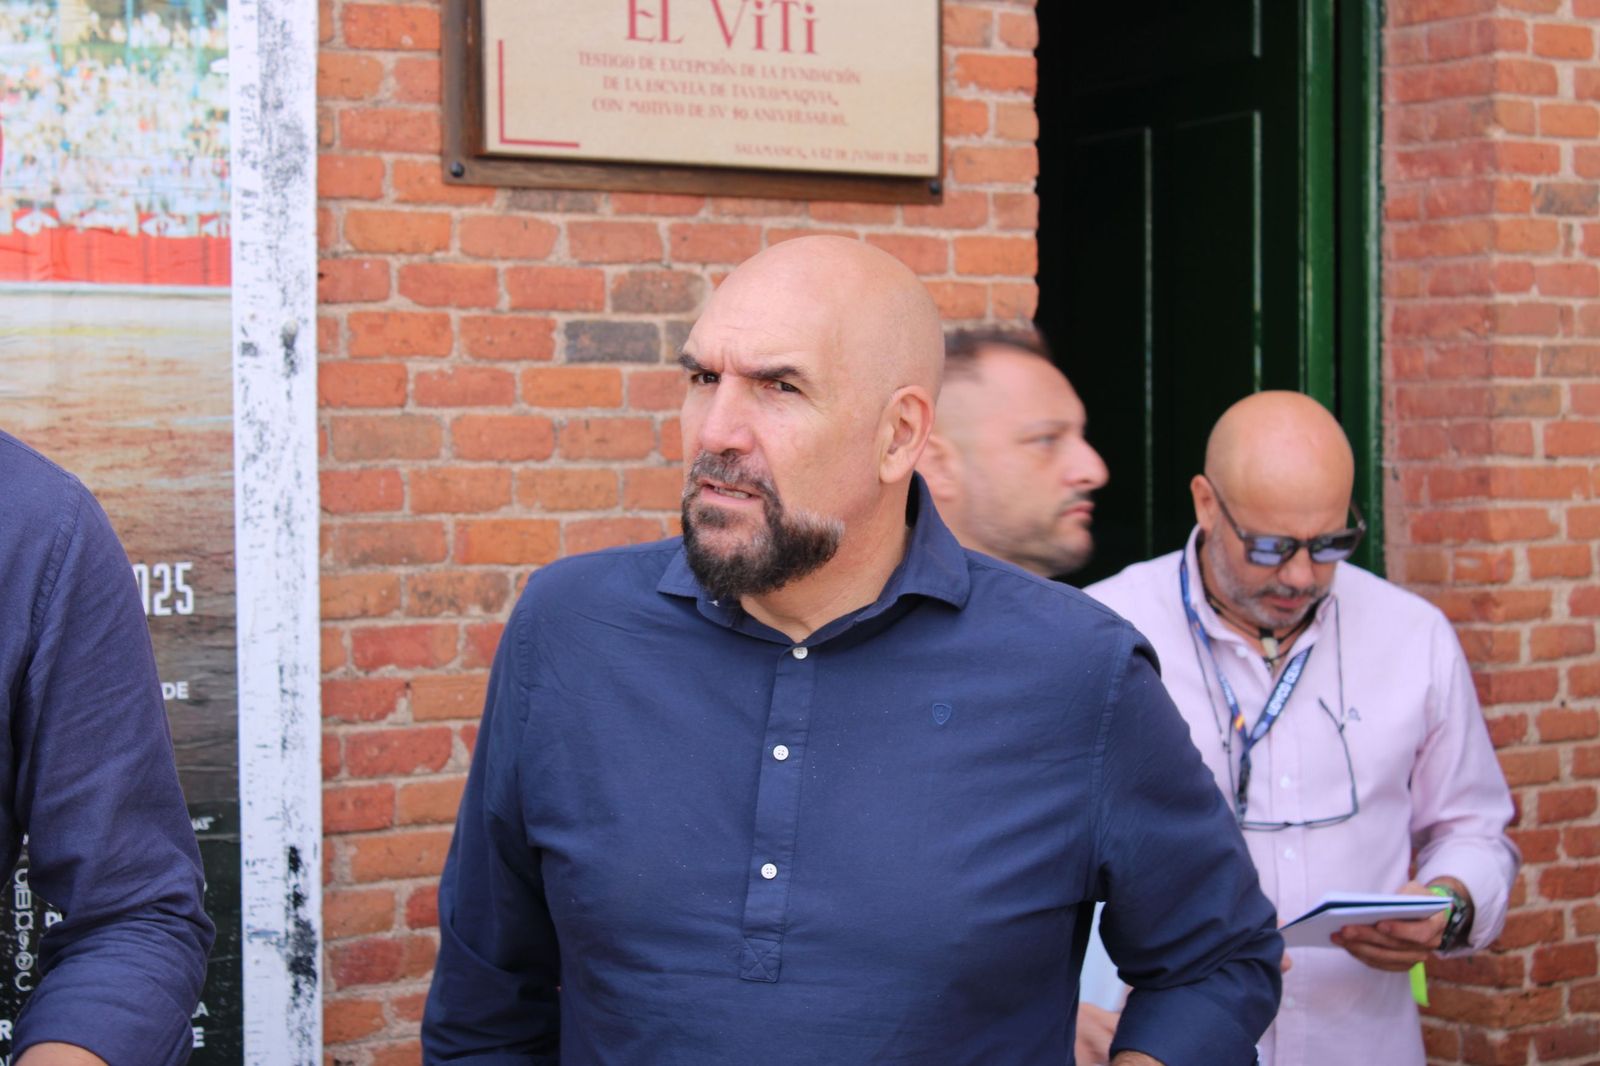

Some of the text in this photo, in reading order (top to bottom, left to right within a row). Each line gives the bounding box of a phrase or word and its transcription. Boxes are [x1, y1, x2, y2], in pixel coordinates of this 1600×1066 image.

[625, 0, 819, 54] EL ViTi
[578, 51, 635, 69] TESTIGO
[638, 55, 656, 71] DE
[660, 57, 736, 75] EXCEPCIÓN
[740, 62, 755, 78] DE
[761, 64, 777, 79] LA
[602, 75, 619, 90] DE
[625, 77, 643, 92] LA
[709, 82, 725, 97] DE
[592, 97, 624, 113] CON
[688, 102, 704, 118] DE
[132, 561, 195, 617] 025
